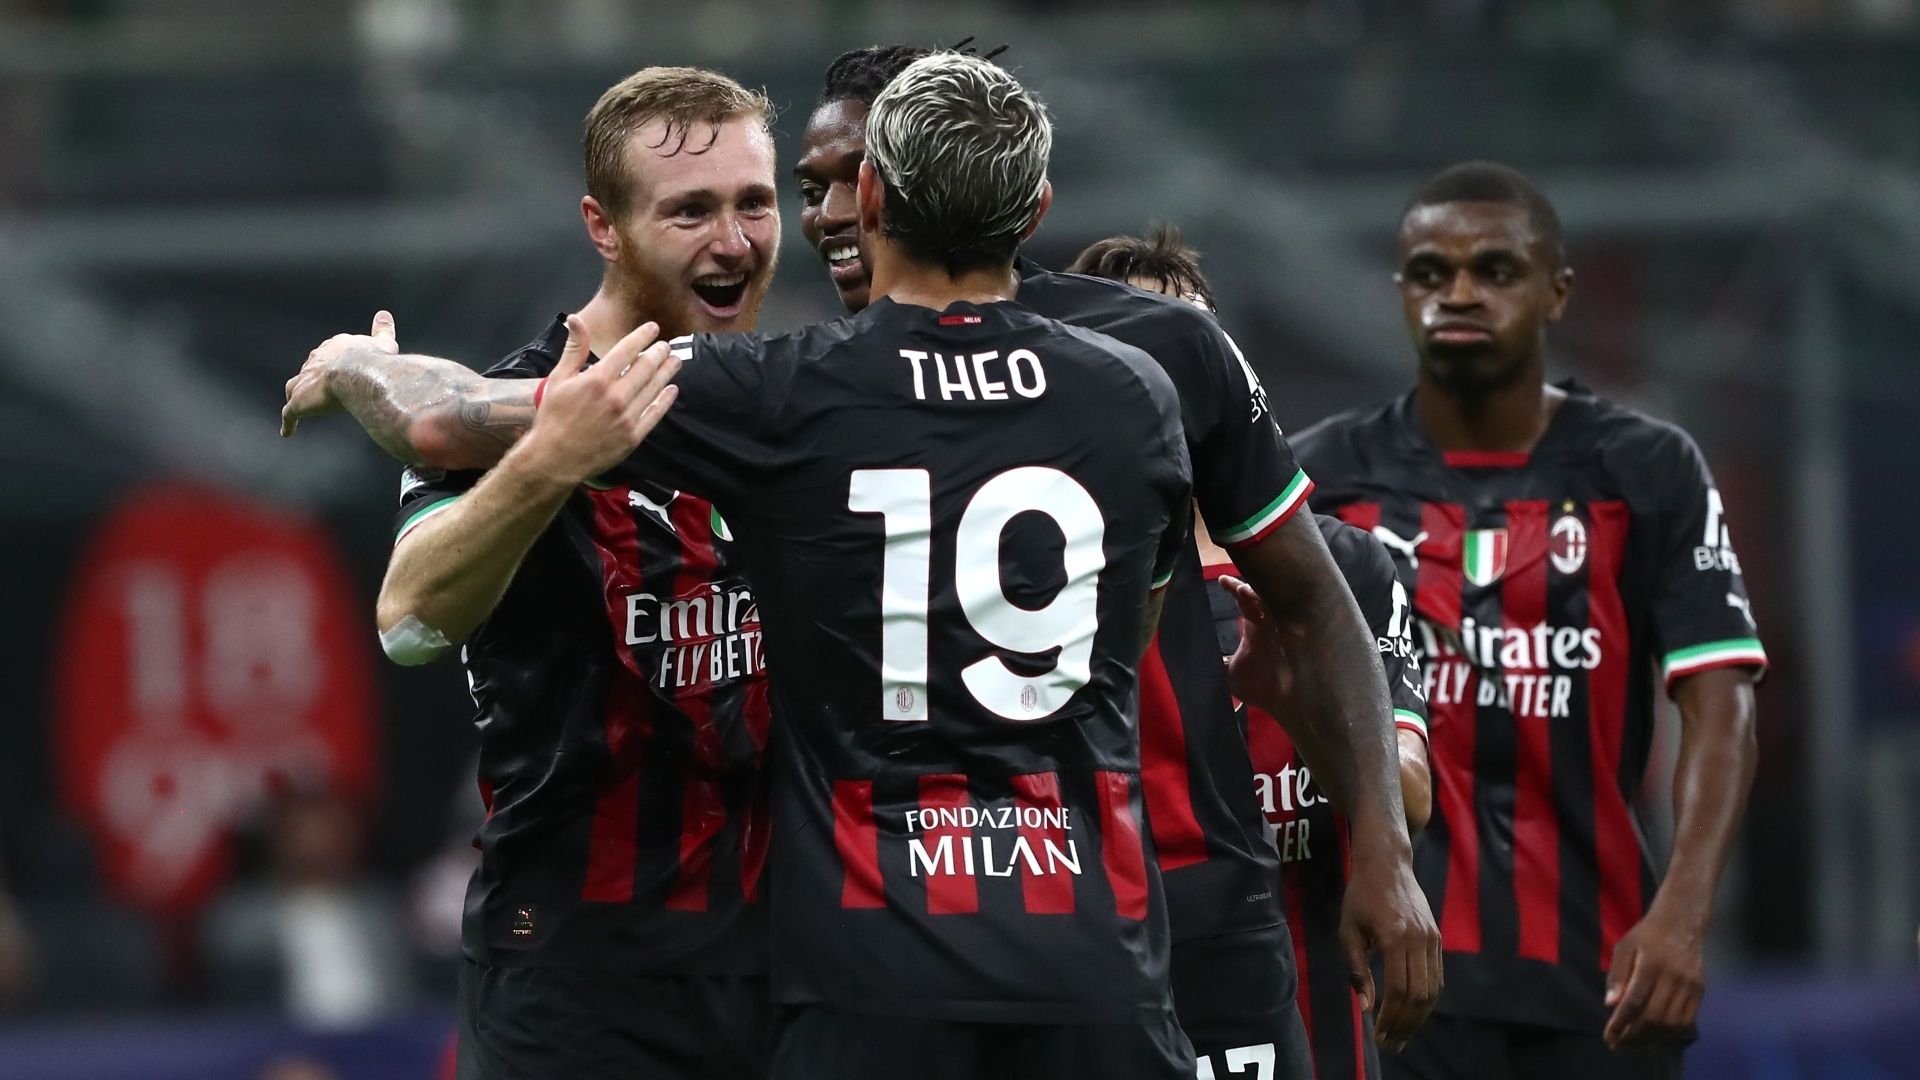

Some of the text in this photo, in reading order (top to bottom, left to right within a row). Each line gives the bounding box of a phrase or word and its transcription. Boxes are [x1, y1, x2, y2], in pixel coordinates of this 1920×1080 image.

[899, 348, 1047, 401] THEO
[848, 465, 1107, 722] 19
[659, 644, 707, 688] FLY
[1423, 660, 1473, 704] FLY
[1253, 762, 1329, 813] ate
[905, 806, 1072, 833] FONDAZIONE
[907, 835, 1083, 877] MILAN
